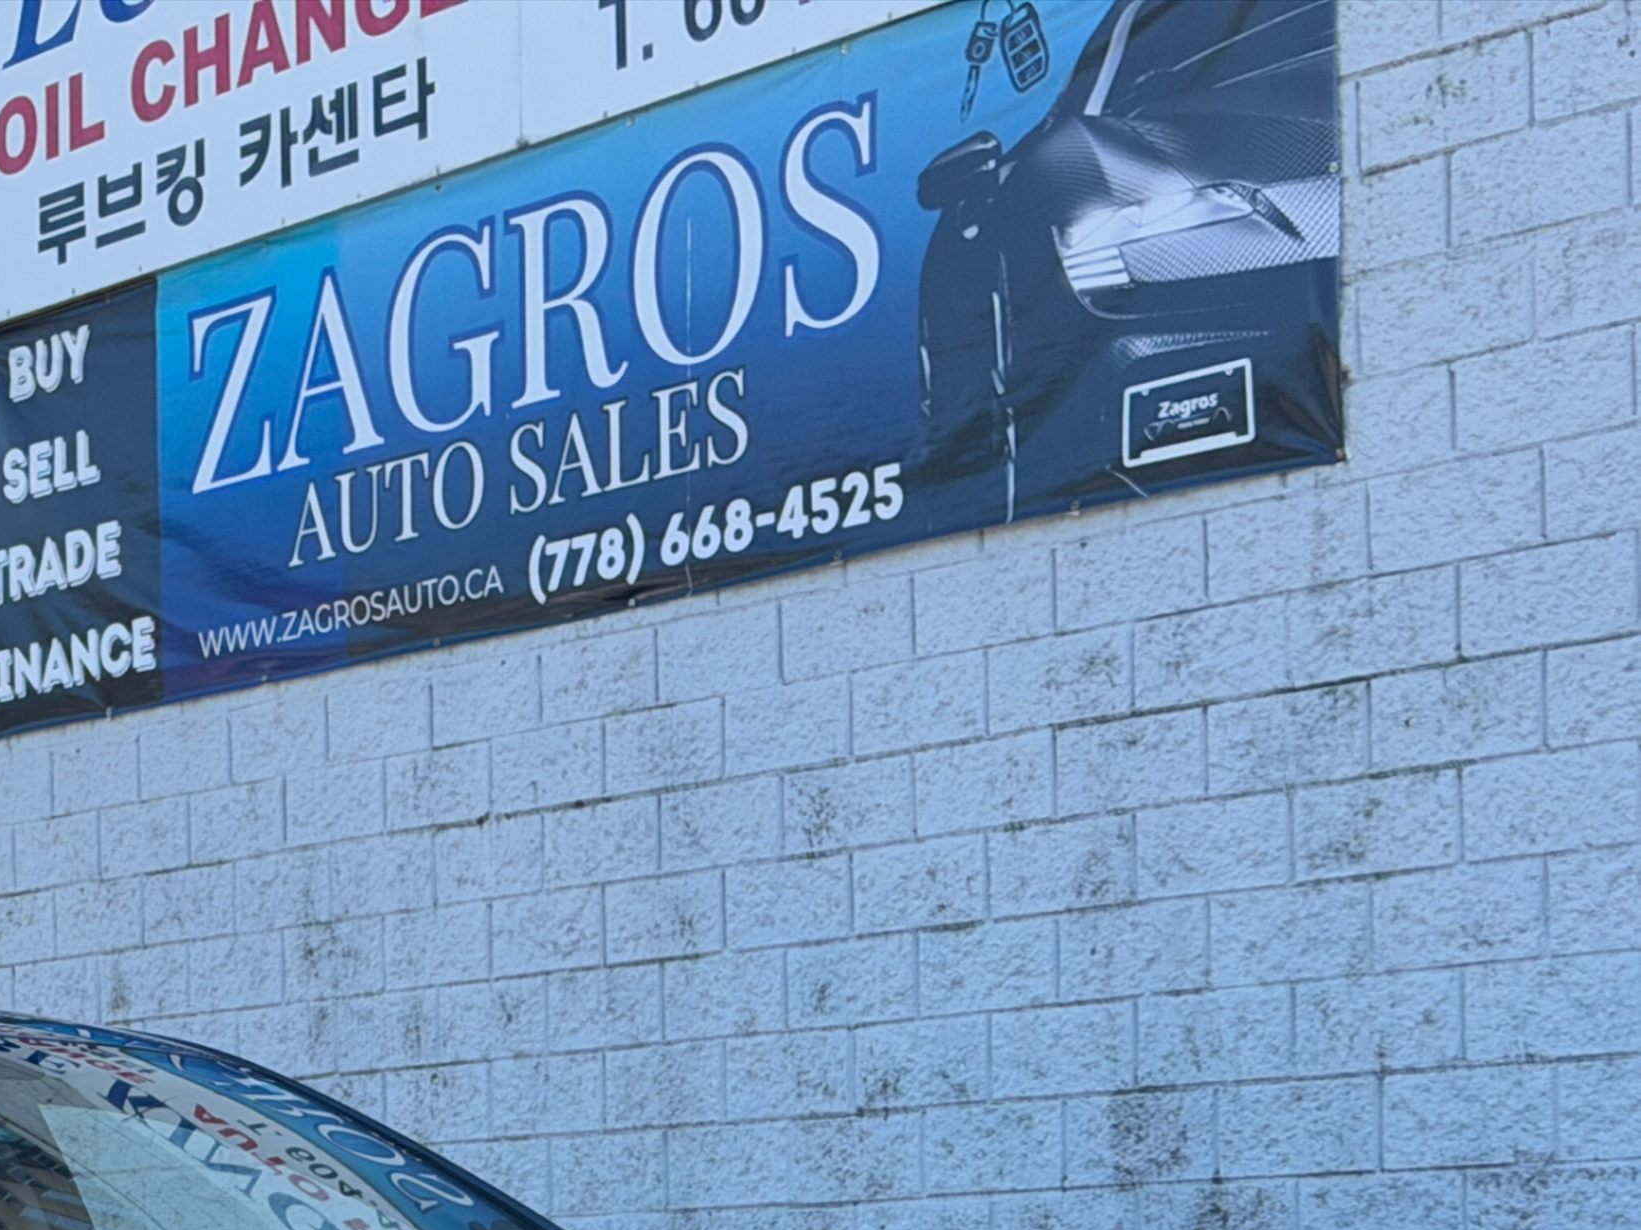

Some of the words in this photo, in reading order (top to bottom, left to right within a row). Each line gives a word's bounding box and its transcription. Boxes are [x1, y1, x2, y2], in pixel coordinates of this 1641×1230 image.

[37, 136, 206, 266] 루브킹
[239, 57, 436, 189] 카센타
[190, 97, 883, 496] ZAGROS
[7, 323, 92, 403] BUY
[1158, 391, 1220, 419] Zagros
[1, 429, 102, 504] SELL
[288, 438, 486, 569] AUTO
[508, 369, 750, 517] SALES
[528, 514, 646, 605] (778)
[659, 462, 906, 569] 668-4525
[197, 565, 506, 661] WWW.ZAGROSAUTO.CA
